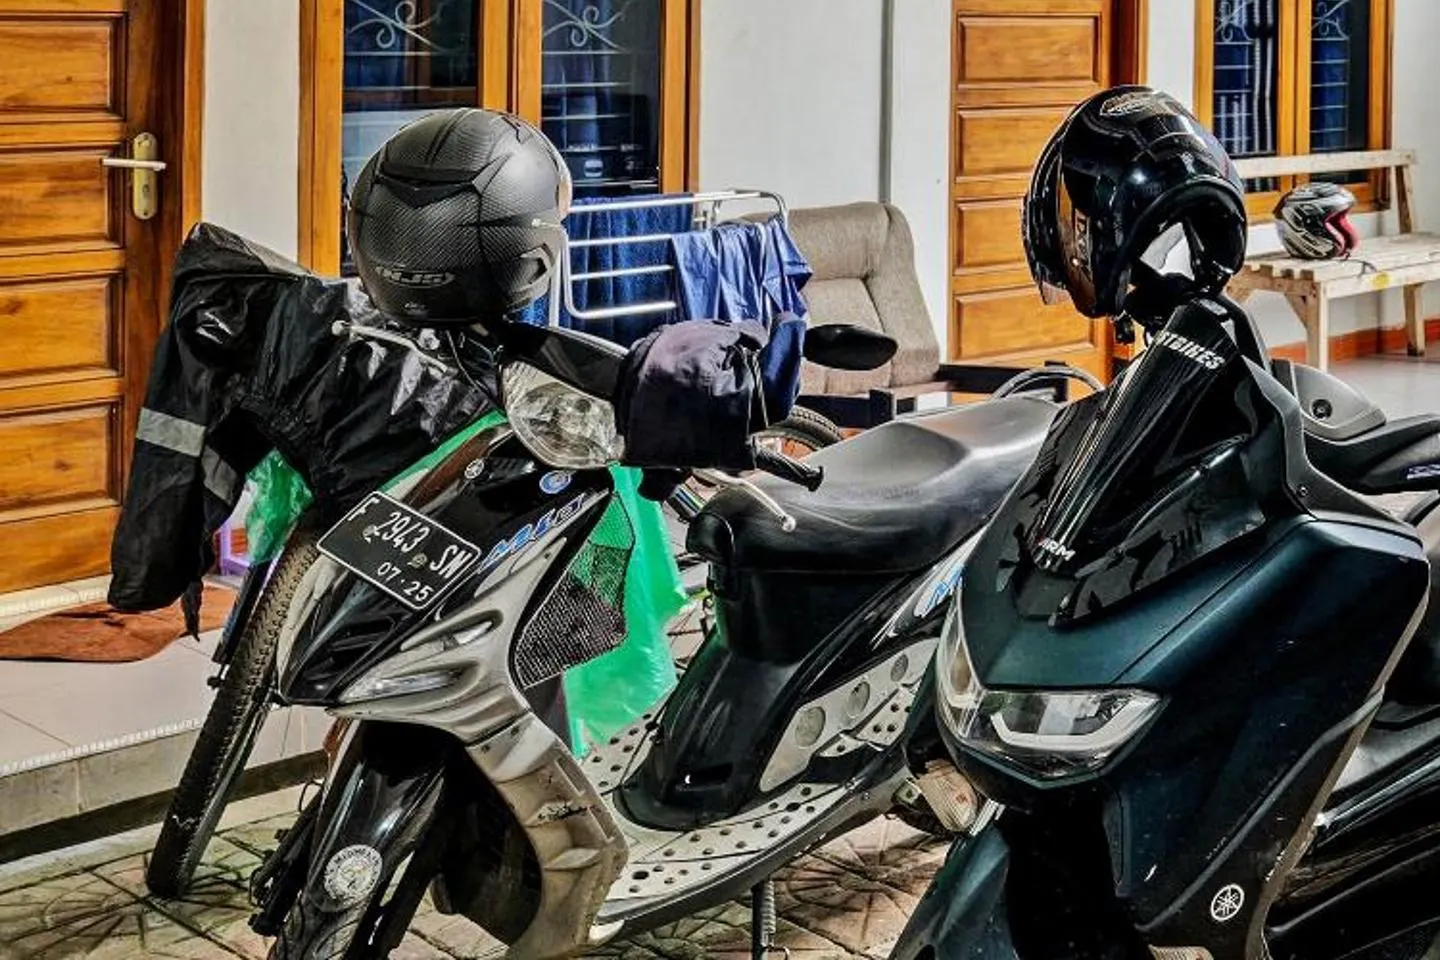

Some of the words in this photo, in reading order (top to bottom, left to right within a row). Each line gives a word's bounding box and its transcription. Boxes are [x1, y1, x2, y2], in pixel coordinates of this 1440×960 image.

[347, 496, 380, 522] F
[373, 511, 431, 553] 2943
[430, 544, 472, 579] SN
